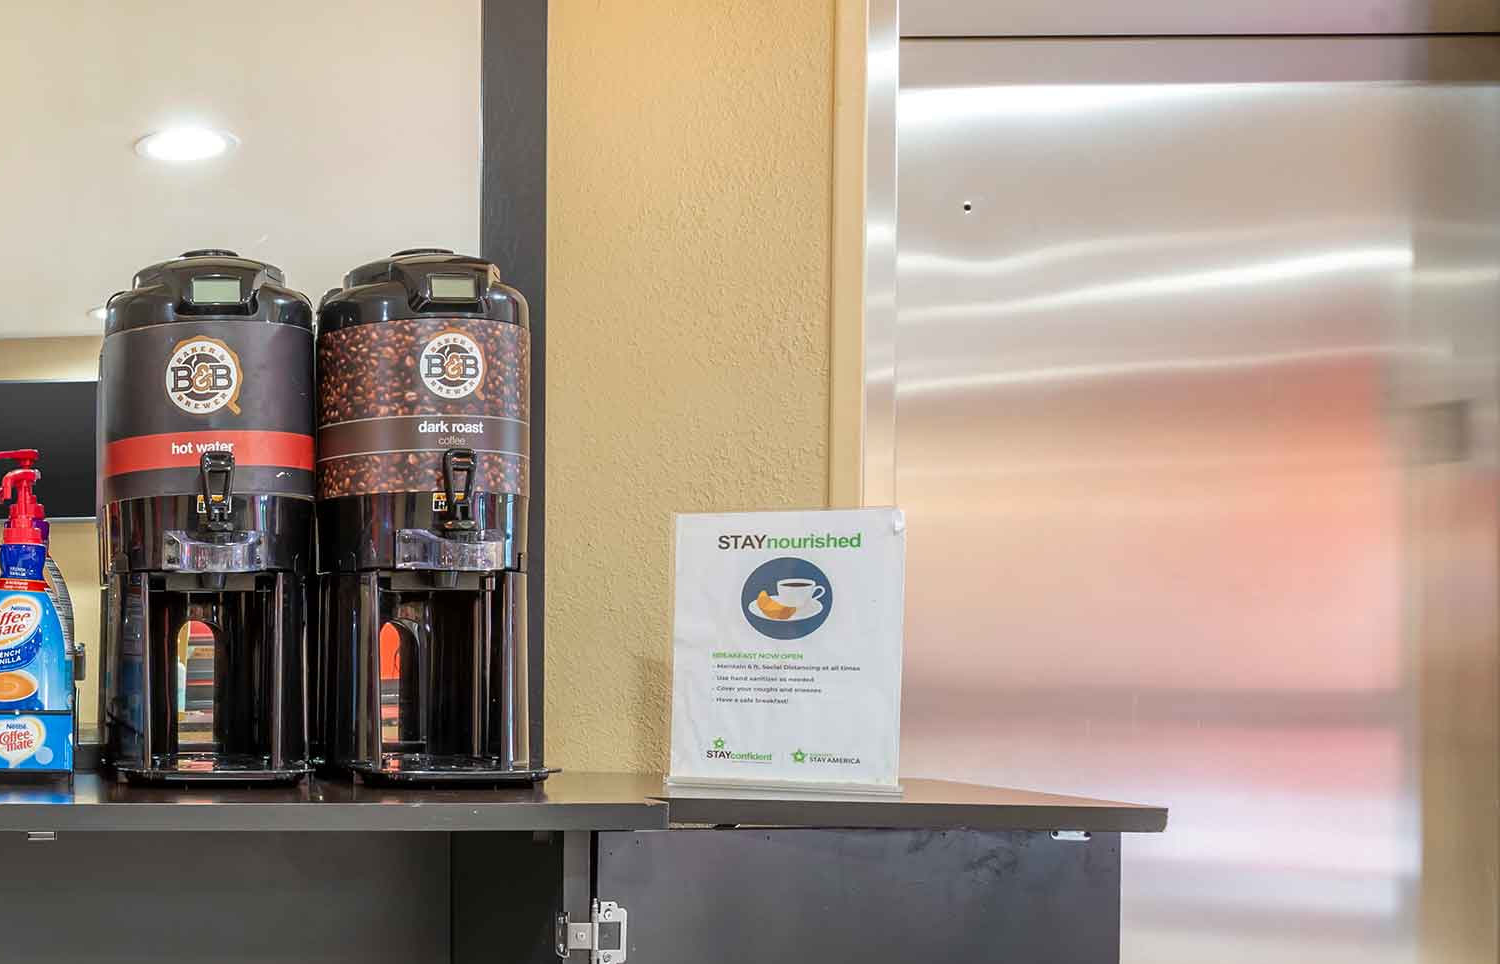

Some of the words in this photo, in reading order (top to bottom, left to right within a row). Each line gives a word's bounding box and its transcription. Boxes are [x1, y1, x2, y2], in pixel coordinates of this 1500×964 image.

[424, 352, 480, 381] B&B
[170, 363, 233, 393] B&B
[418, 420, 449, 433] dark
[451, 421, 484, 433] roast
[438, 436, 466, 445] coffee
[171, 441, 194, 455] hot
[196, 441, 234, 453] water
[717, 532, 862, 550] STAYnourished
[6, 740, 33, 752] mate
